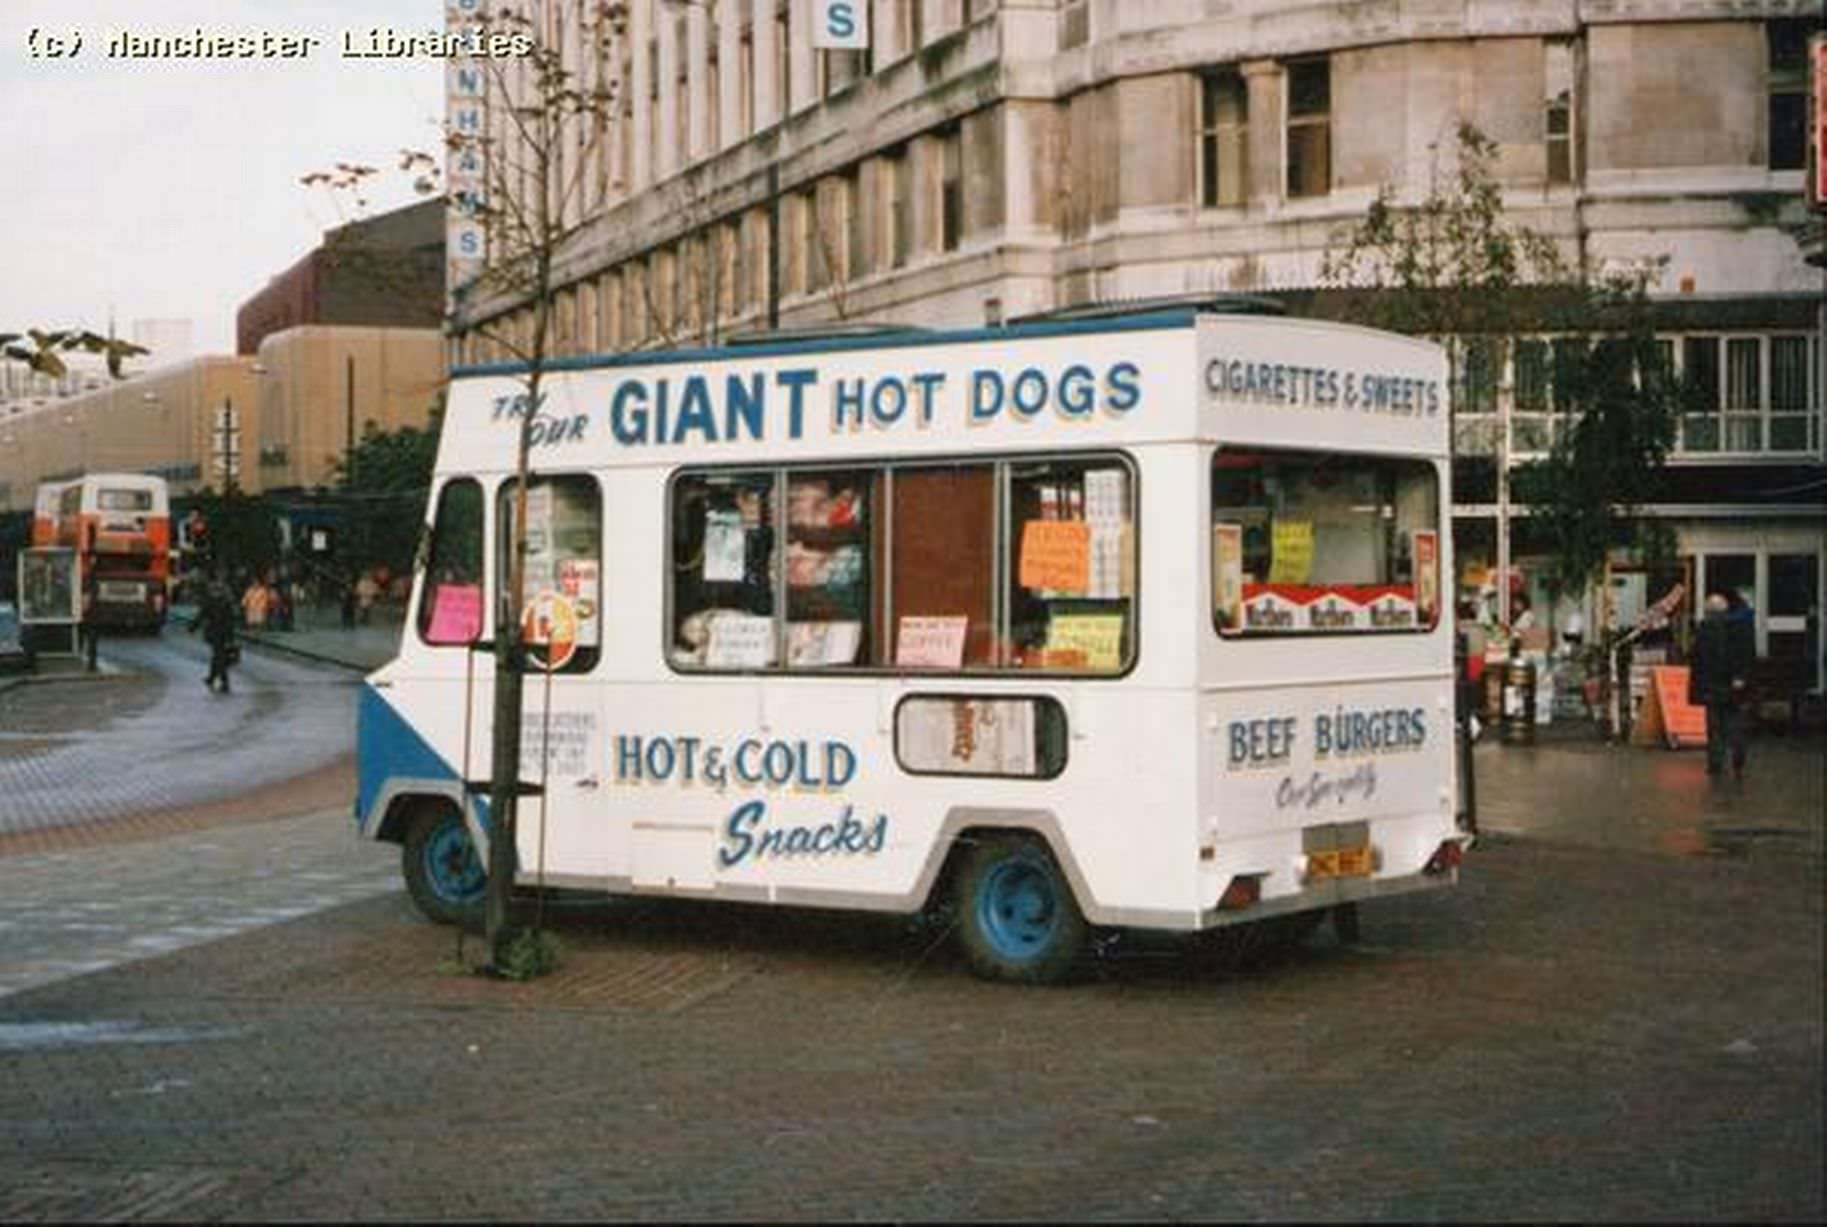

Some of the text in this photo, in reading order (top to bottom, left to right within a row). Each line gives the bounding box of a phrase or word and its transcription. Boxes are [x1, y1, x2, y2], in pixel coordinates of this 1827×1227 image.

[610, 361, 1141, 447] GIANT HOT DOGS
[1204, 358, 1439, 417] CIGARETTES & SWEETS
[616, 735, 700, 783] HOT
[733, 738, 857, 790] COLD
[1228, 707, 1427, 766] BEEF BURGERS
[716, 799, 889, 869] Snacks
